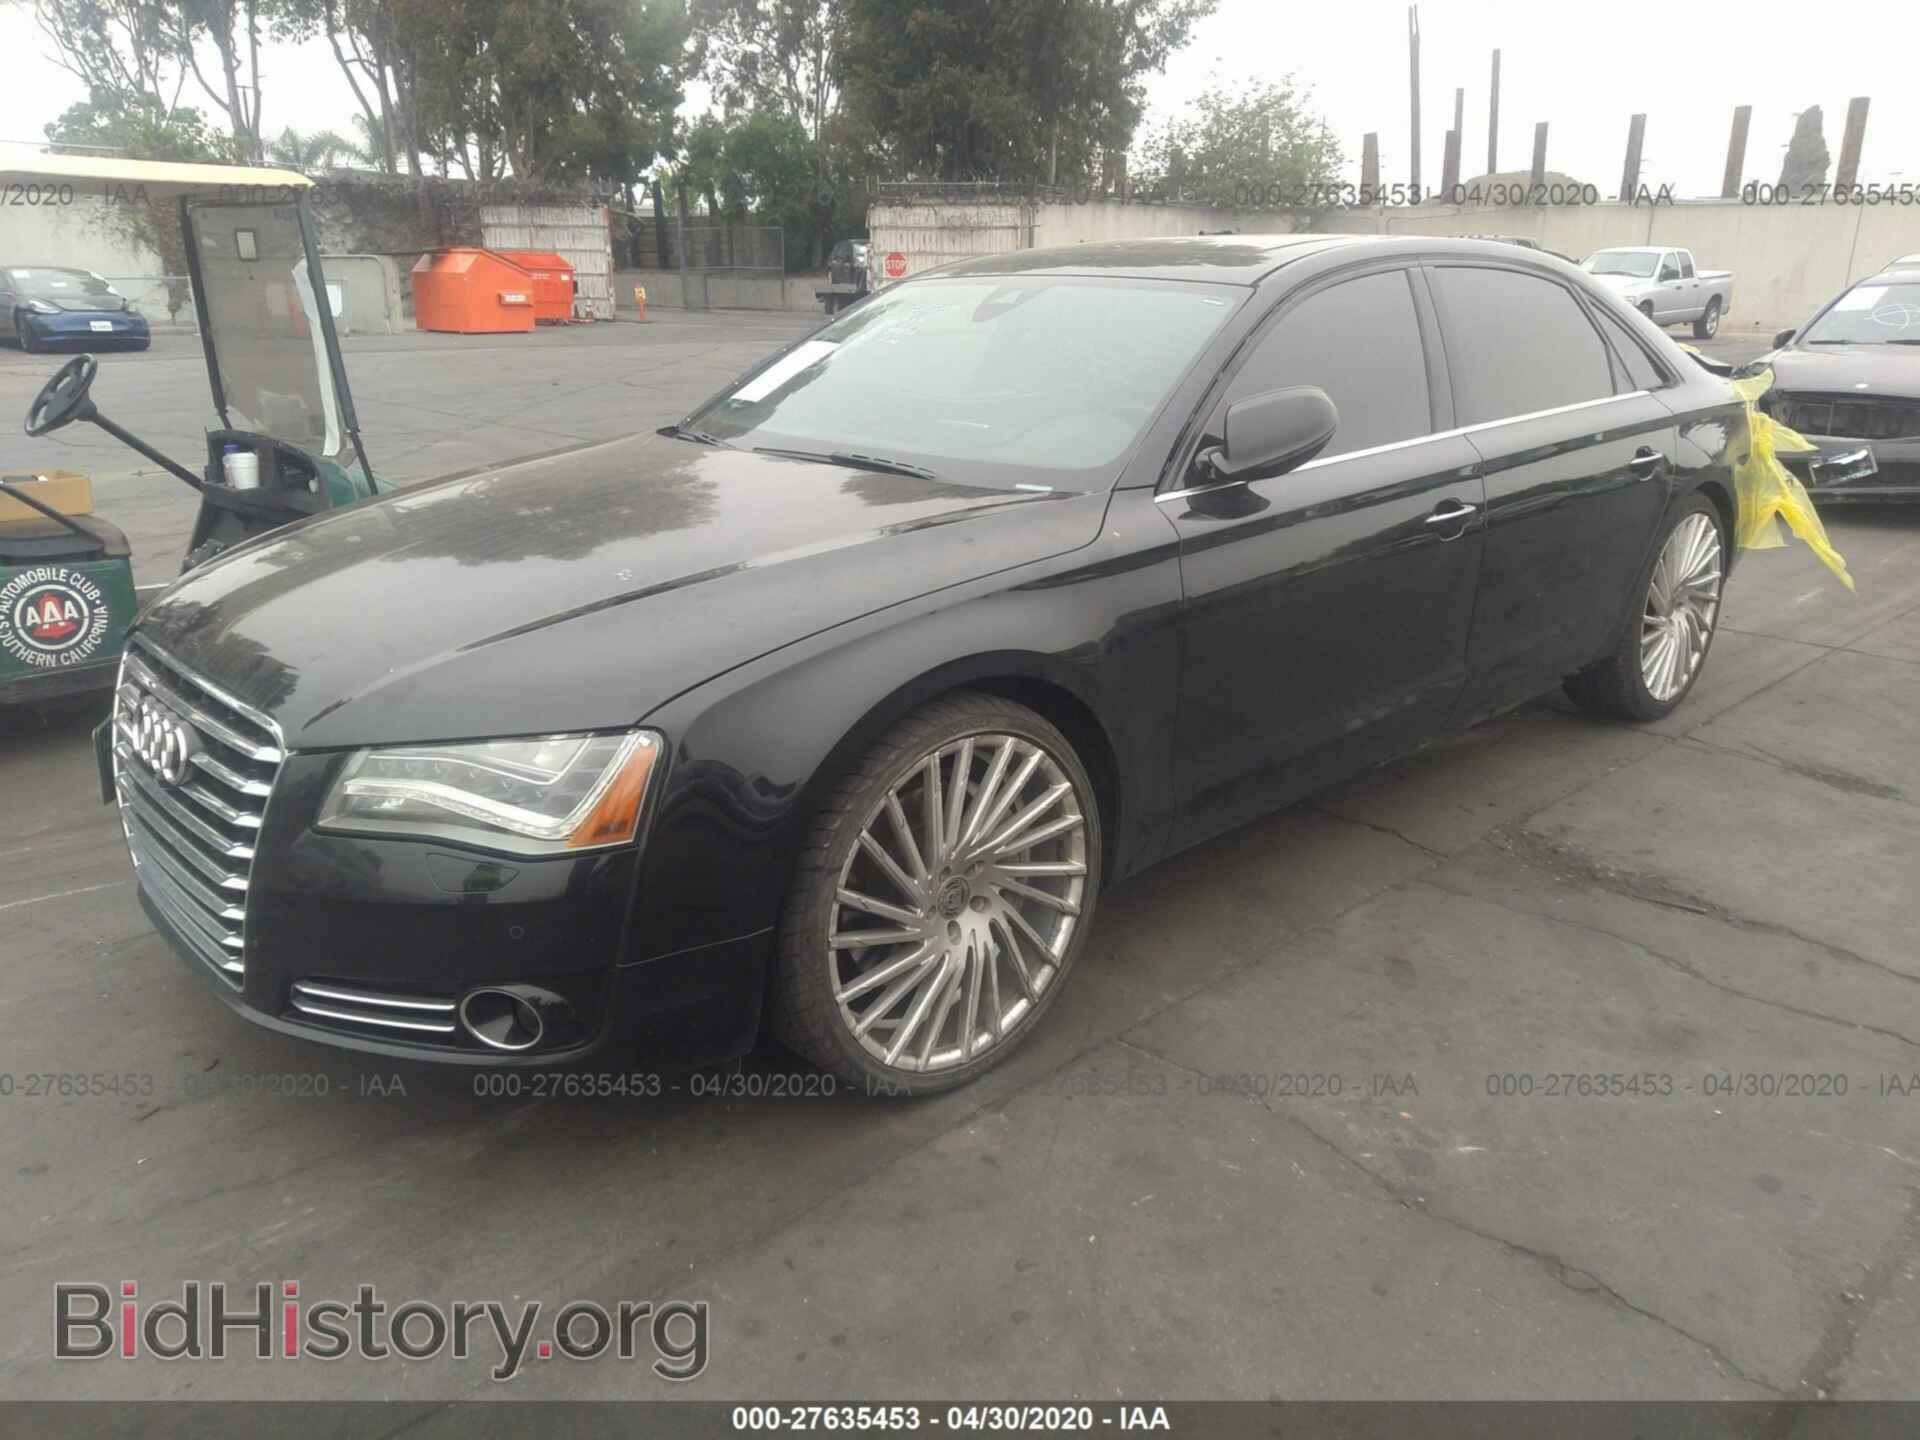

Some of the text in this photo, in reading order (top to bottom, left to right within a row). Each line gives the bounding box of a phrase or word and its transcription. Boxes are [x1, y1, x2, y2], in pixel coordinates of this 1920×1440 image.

[885, 259, 907, 270] STOP
[0, 567, 101, 614] AUTOMOBILE CLUB
[26, 600, 79, 629] AAA
[60, 605, 109, 665] CALIFORNIA
